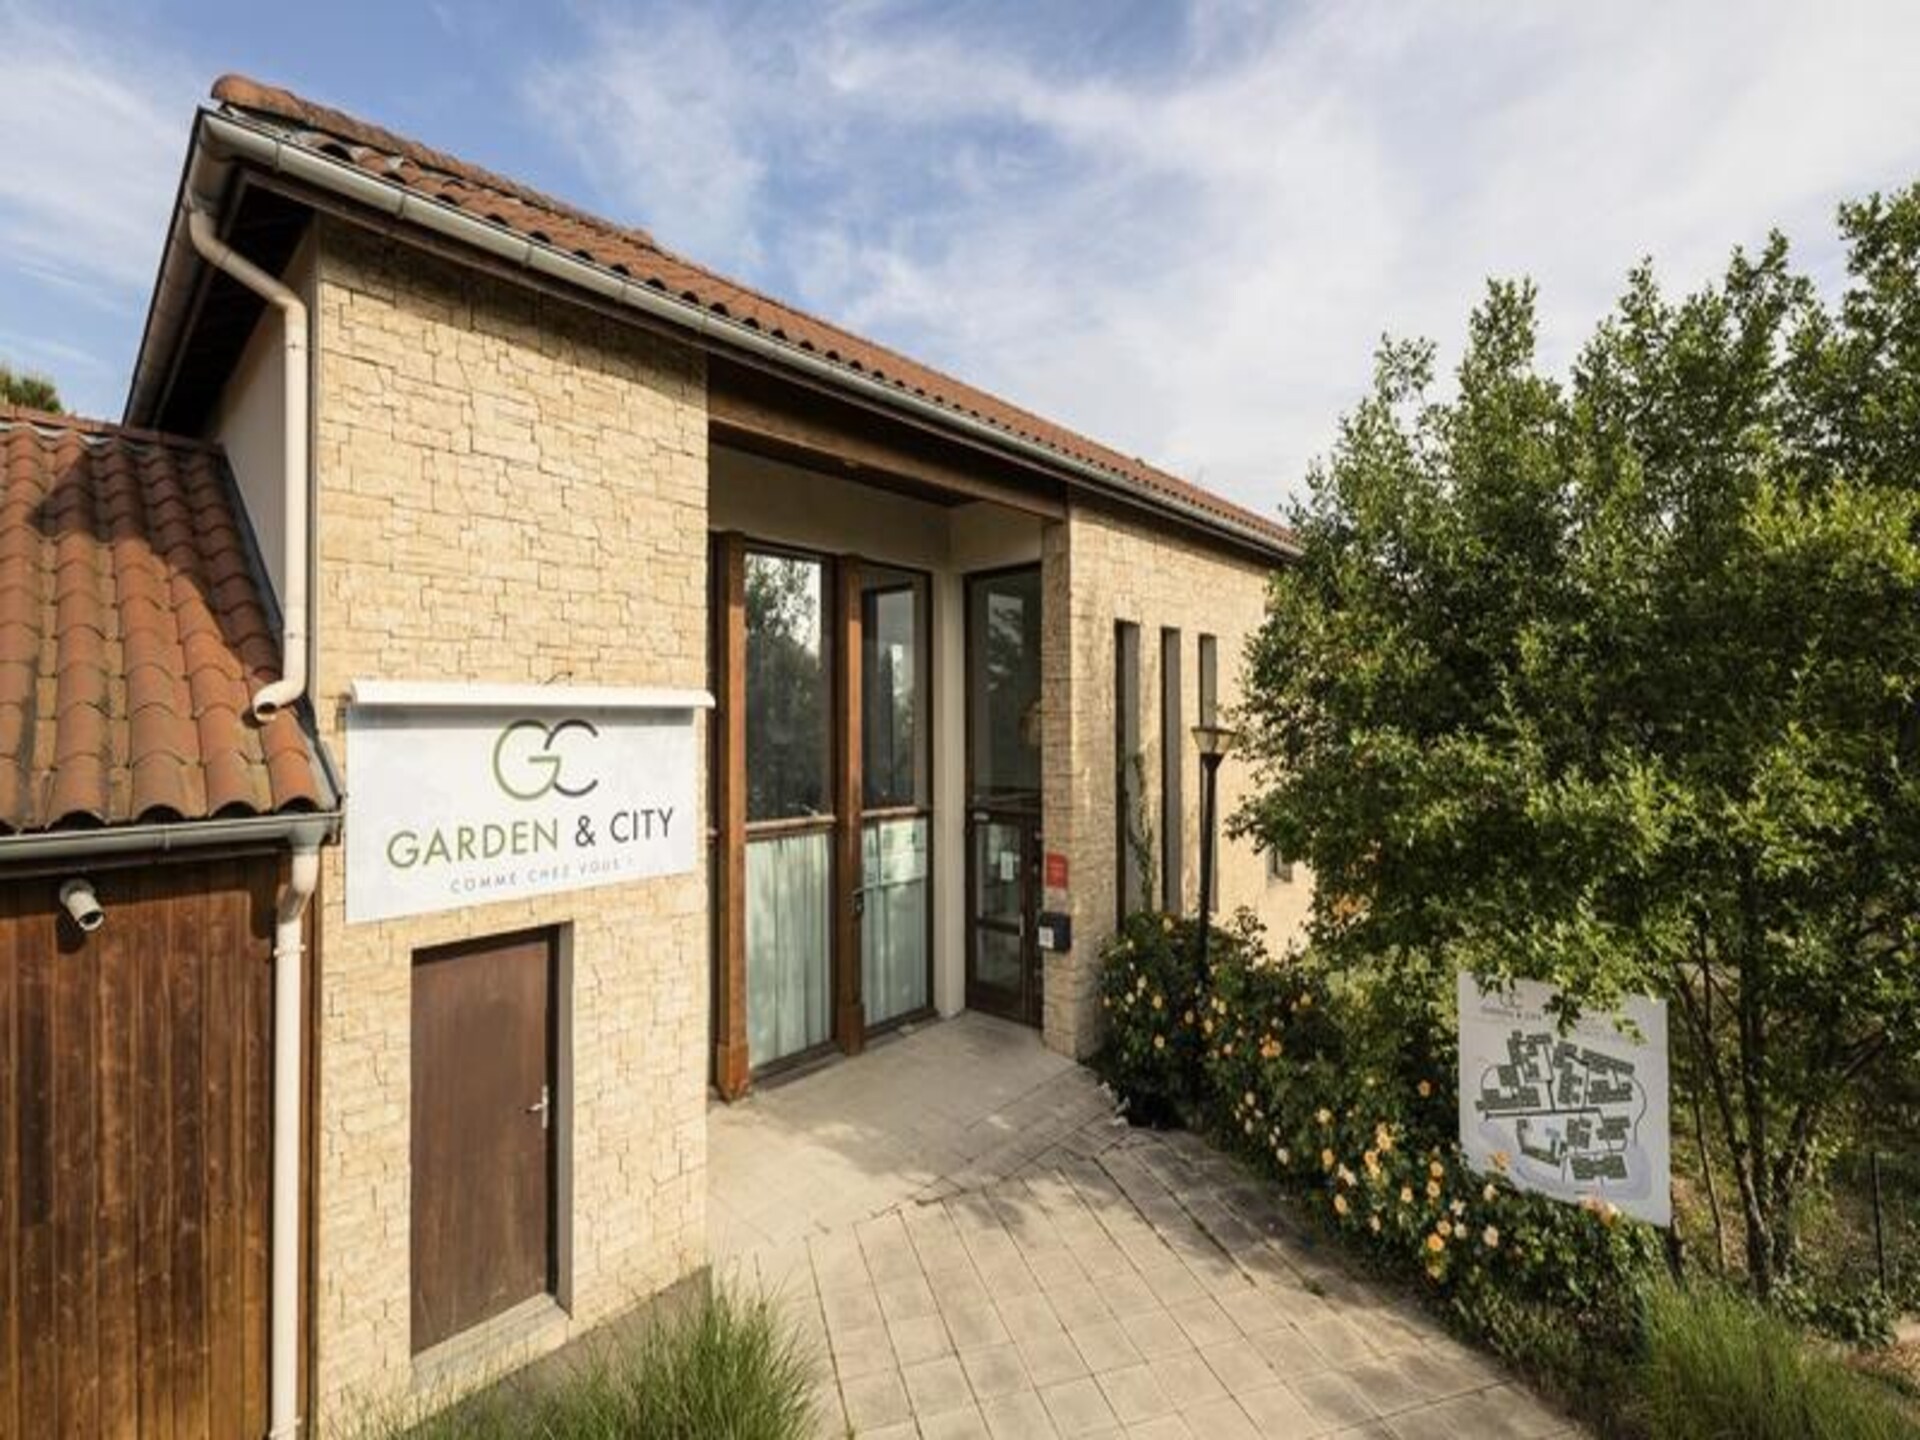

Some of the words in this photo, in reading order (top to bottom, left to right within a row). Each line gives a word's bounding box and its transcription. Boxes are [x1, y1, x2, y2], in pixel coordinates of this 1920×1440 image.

[493, 719, 599, 801] GC
[387, 819, 558, 869] GARDEN
[575, 815, 596, 848] &
[610, 807, 674, 844] CITY
[450, 872, 518, 894] COMME
